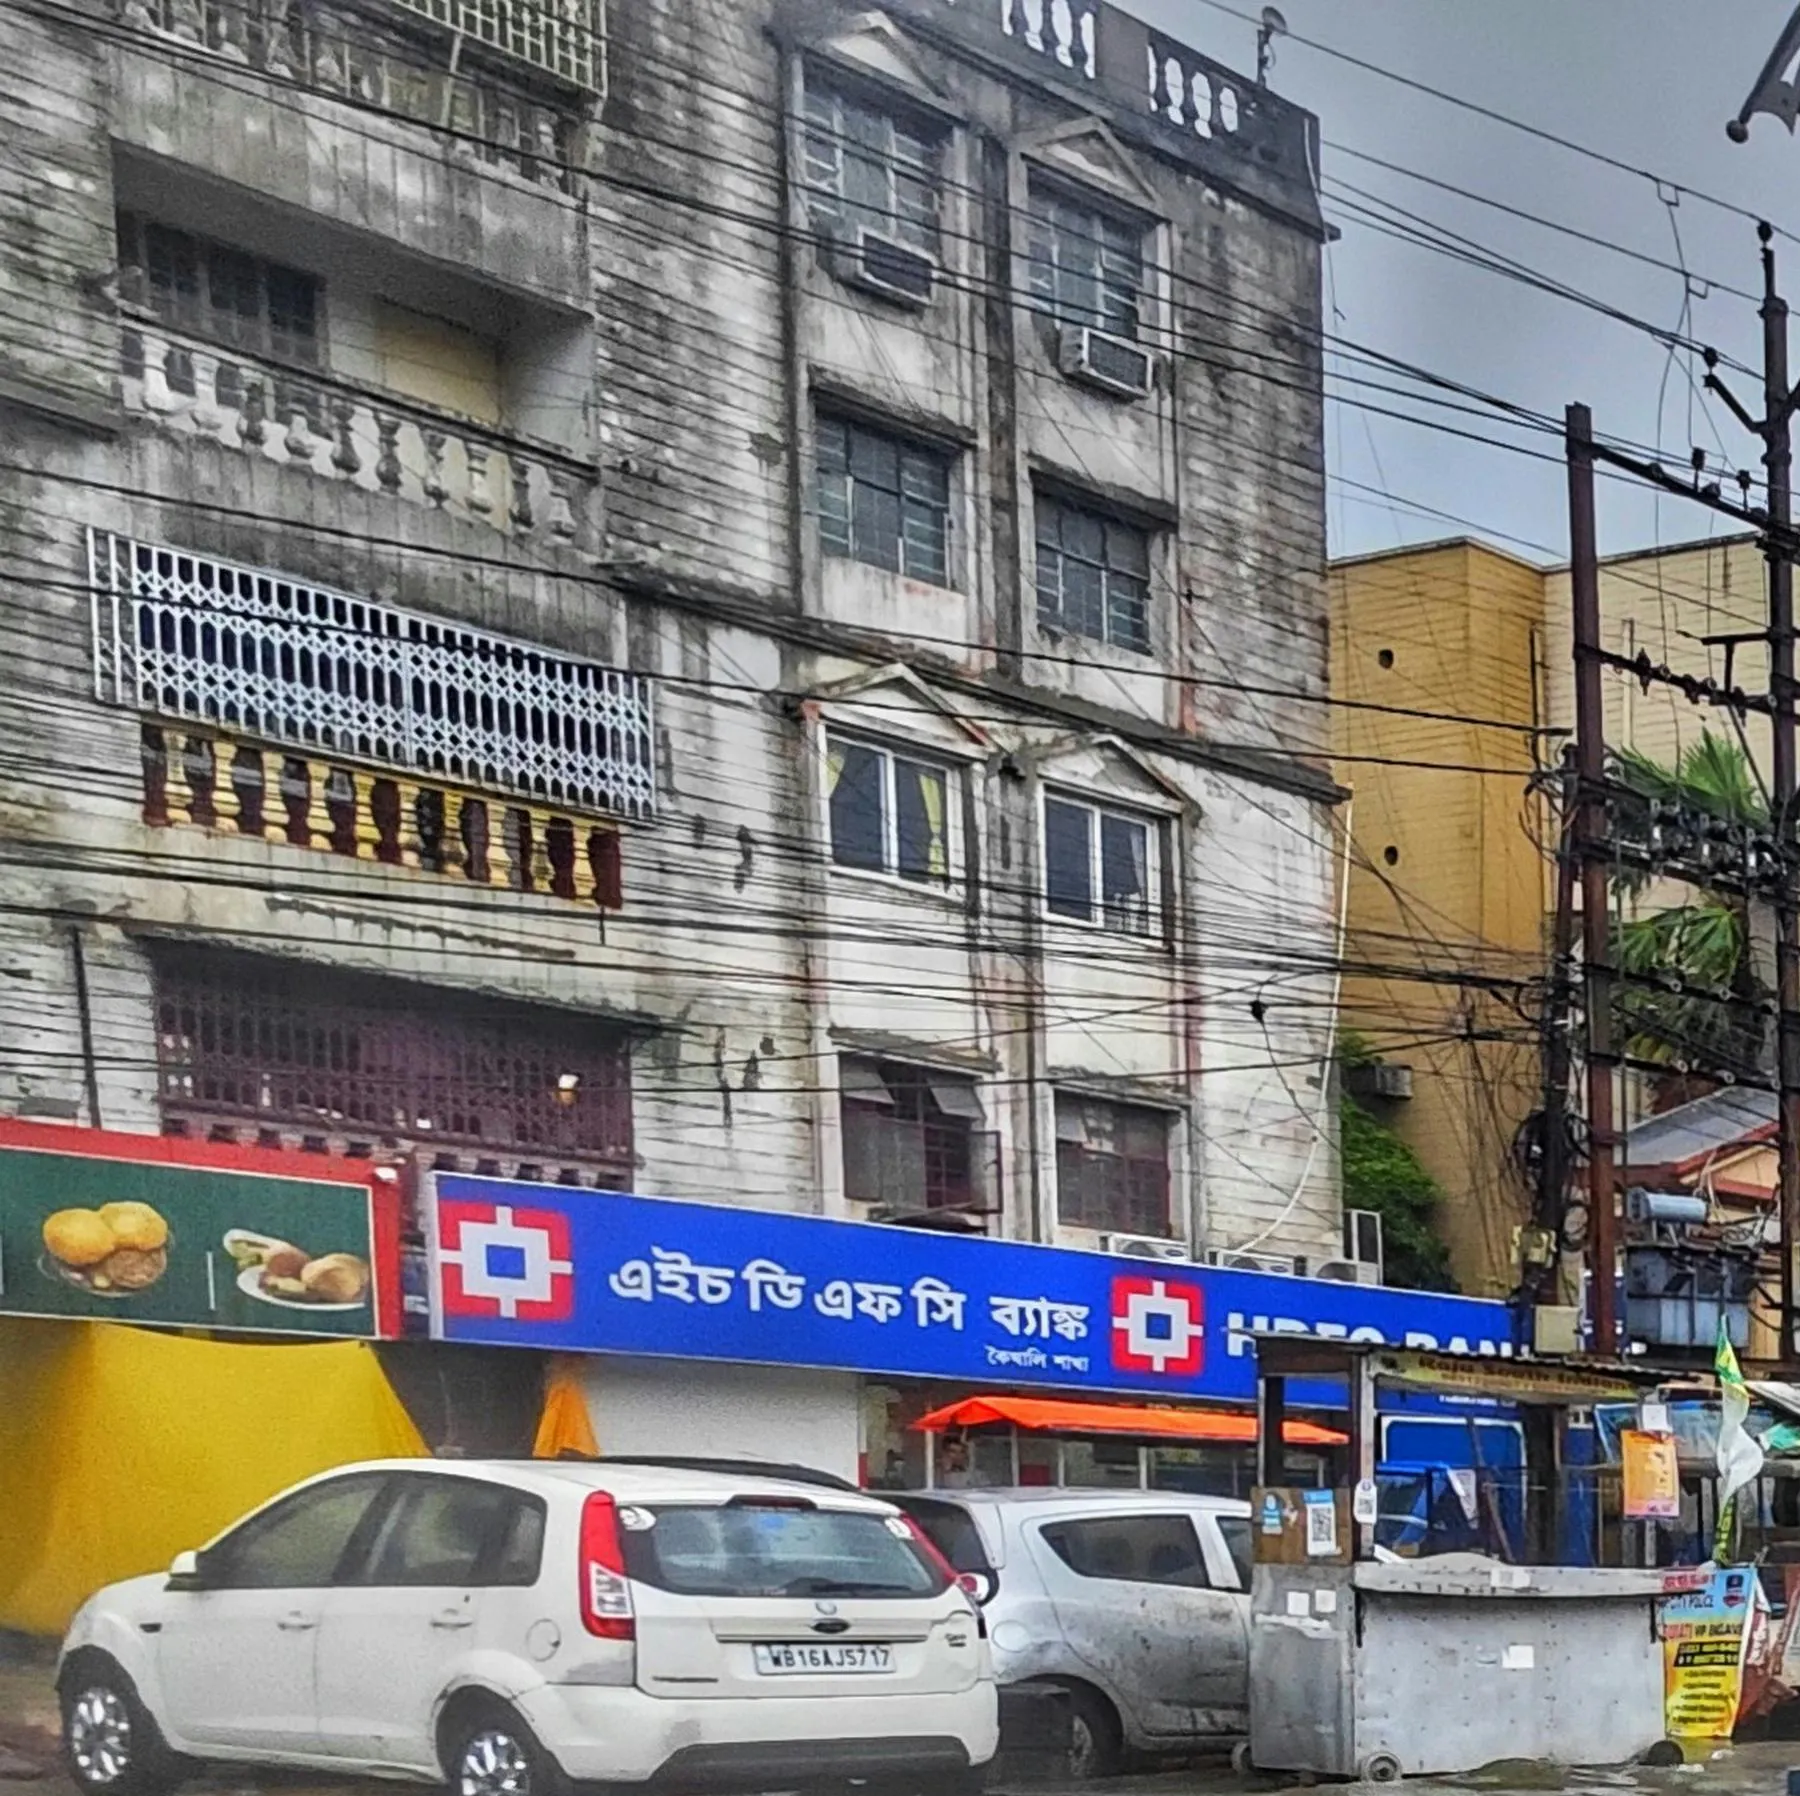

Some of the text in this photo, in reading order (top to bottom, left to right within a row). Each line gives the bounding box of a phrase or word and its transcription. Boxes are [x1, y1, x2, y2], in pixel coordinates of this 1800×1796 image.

[608, 1244, 736, 1304] এইচ
[741, 1258, 807, 1312] ডি
[814, 1279, 903, 1324] এফ
[910, 1276, 967, 1331] সি
[771, 1649, 890, 1668] WB16AJ5717
